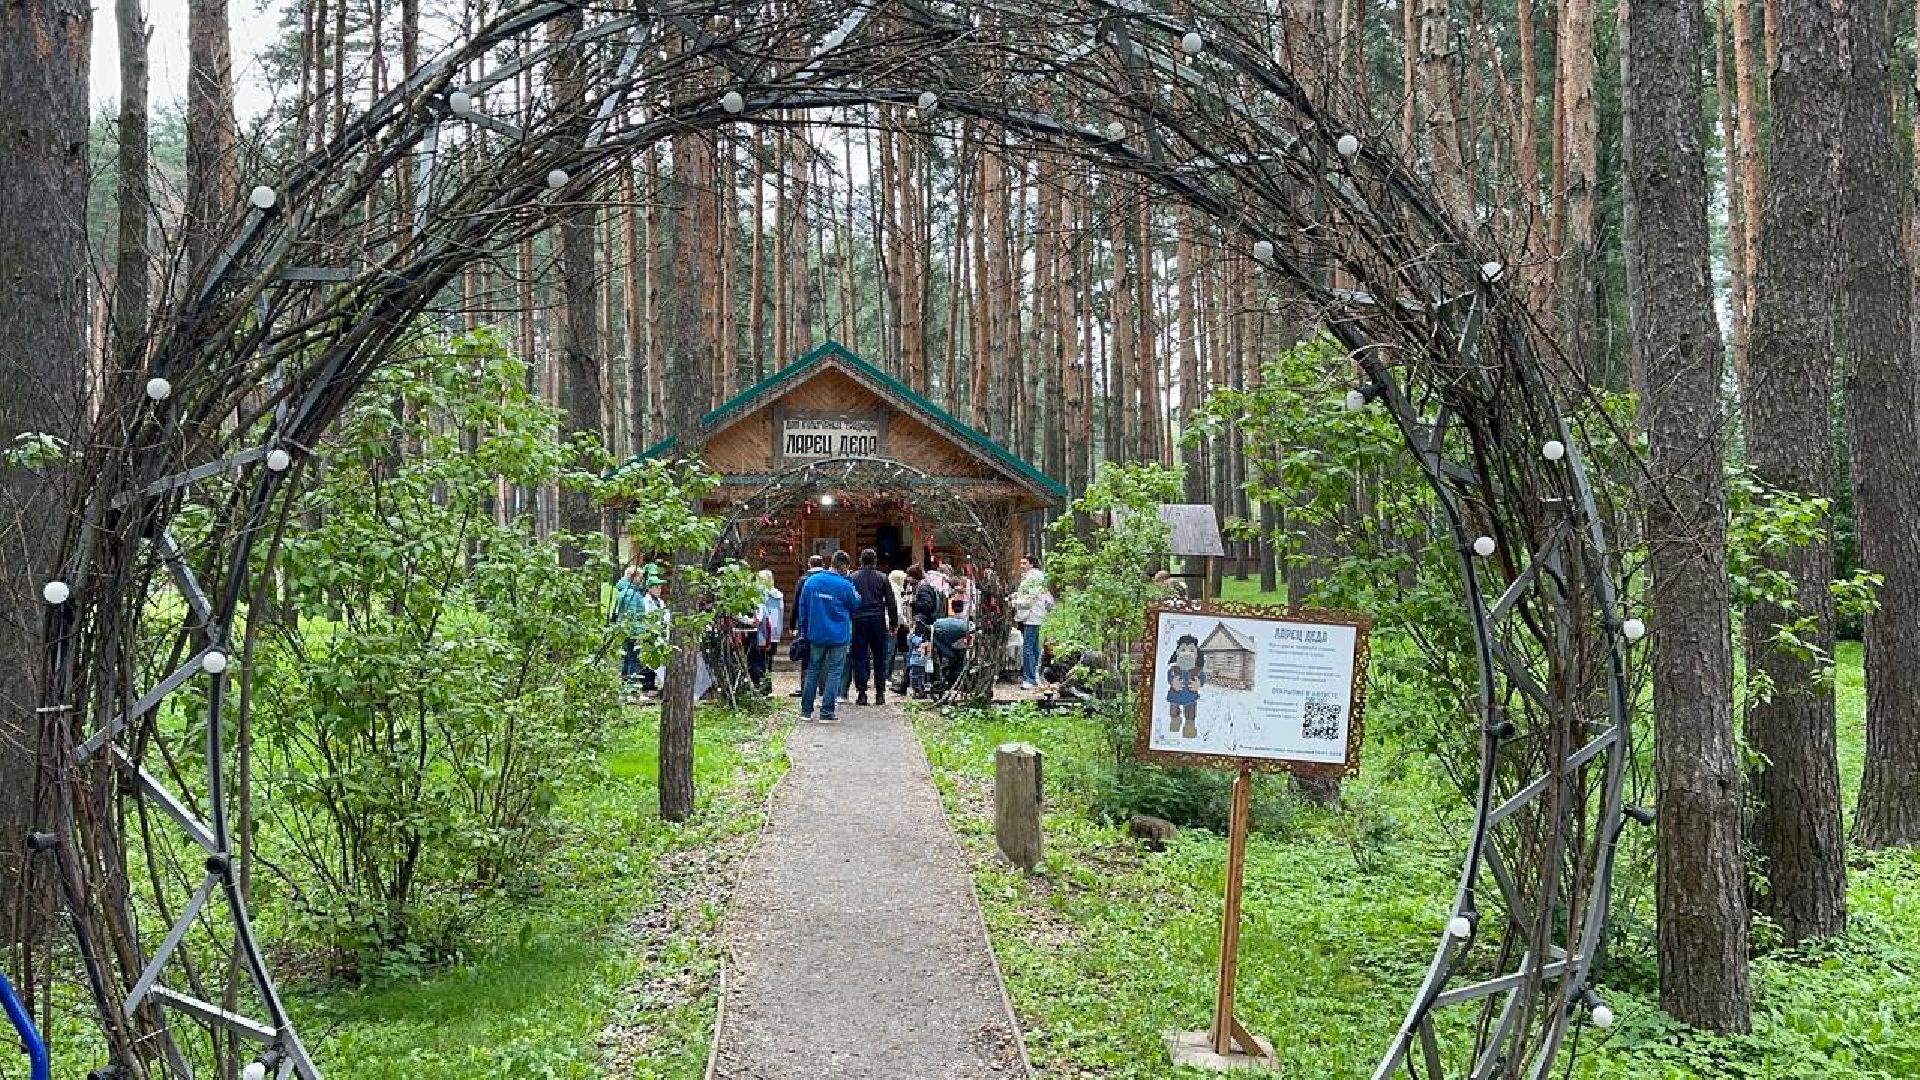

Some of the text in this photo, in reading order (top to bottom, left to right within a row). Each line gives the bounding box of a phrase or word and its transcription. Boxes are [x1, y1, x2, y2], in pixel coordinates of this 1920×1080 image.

[786, 435, 877, 457] ЛАРЕЦ ДЕДА
[1275, 628, 1328, 643] ЛАРЕЦ ДЕДА
